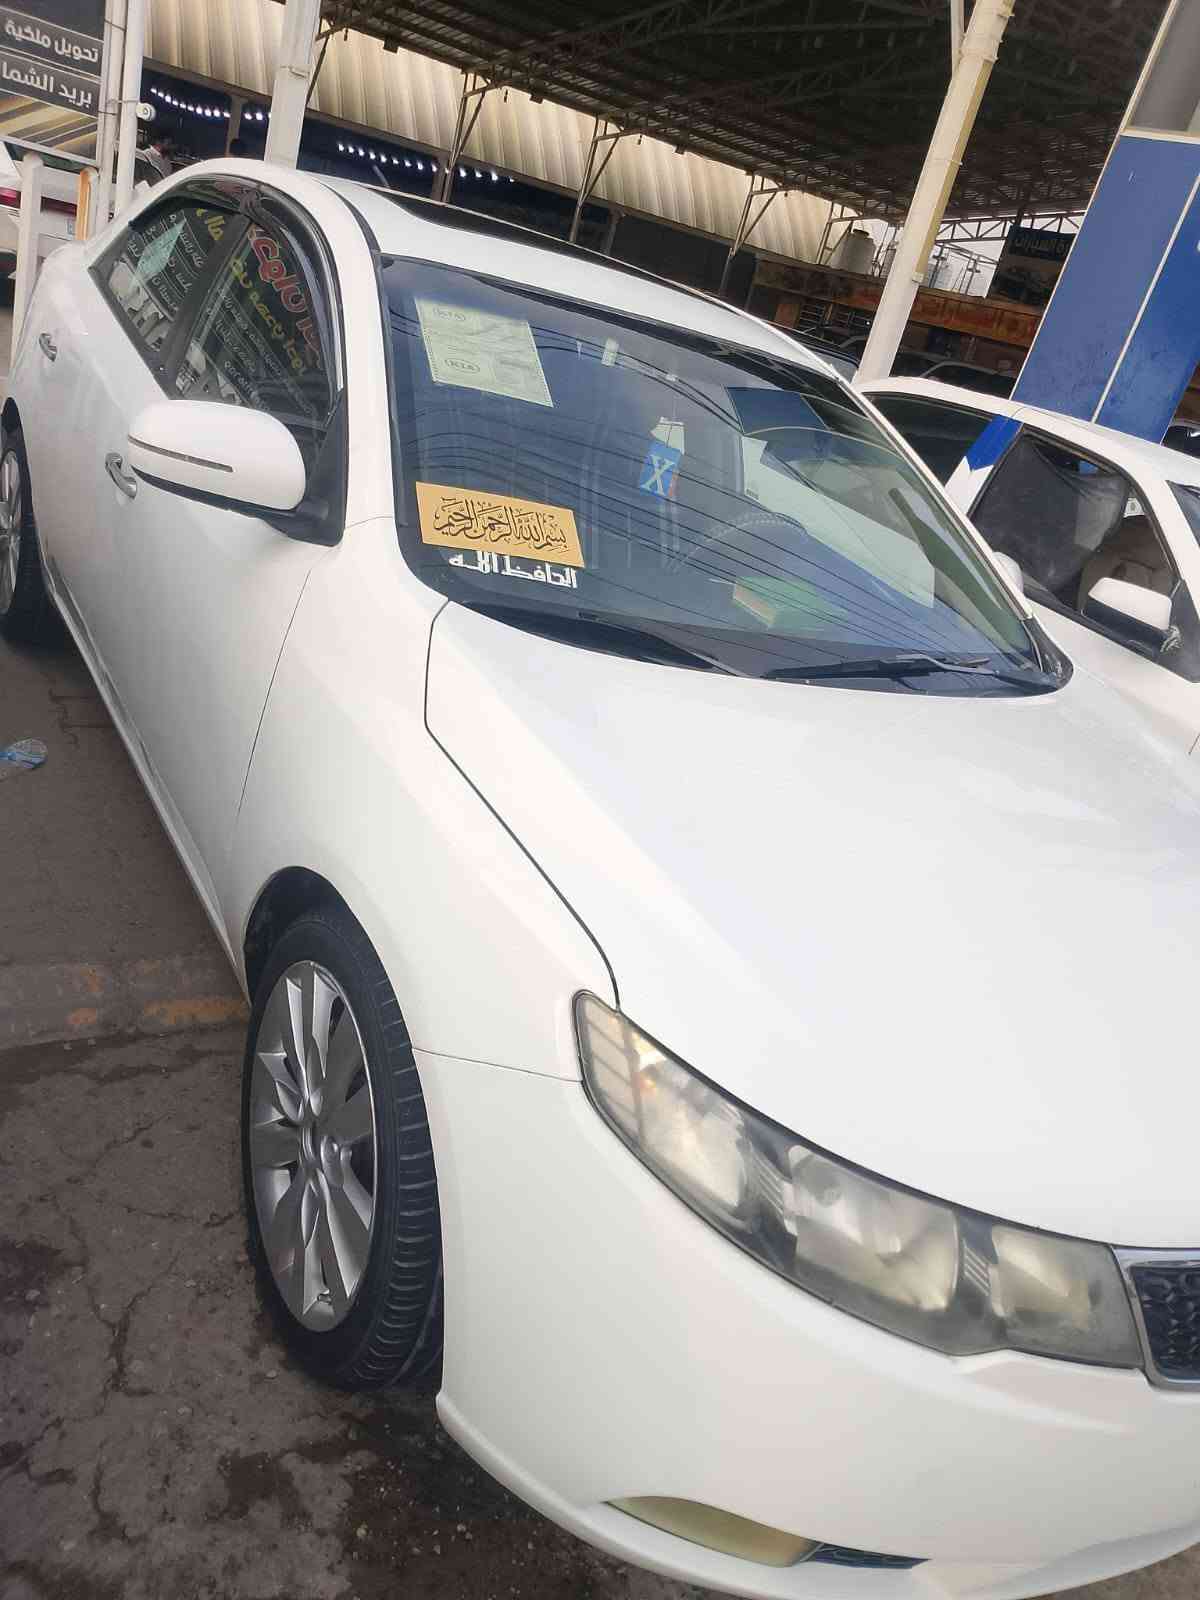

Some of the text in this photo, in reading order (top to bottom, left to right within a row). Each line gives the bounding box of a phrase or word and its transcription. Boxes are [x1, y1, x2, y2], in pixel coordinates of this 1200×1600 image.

[5, 19, 98, 63] تحويل ملكية
[2, 61, 92, 109] بريد الشما
[501, 554, 578, 589] الحافظ
